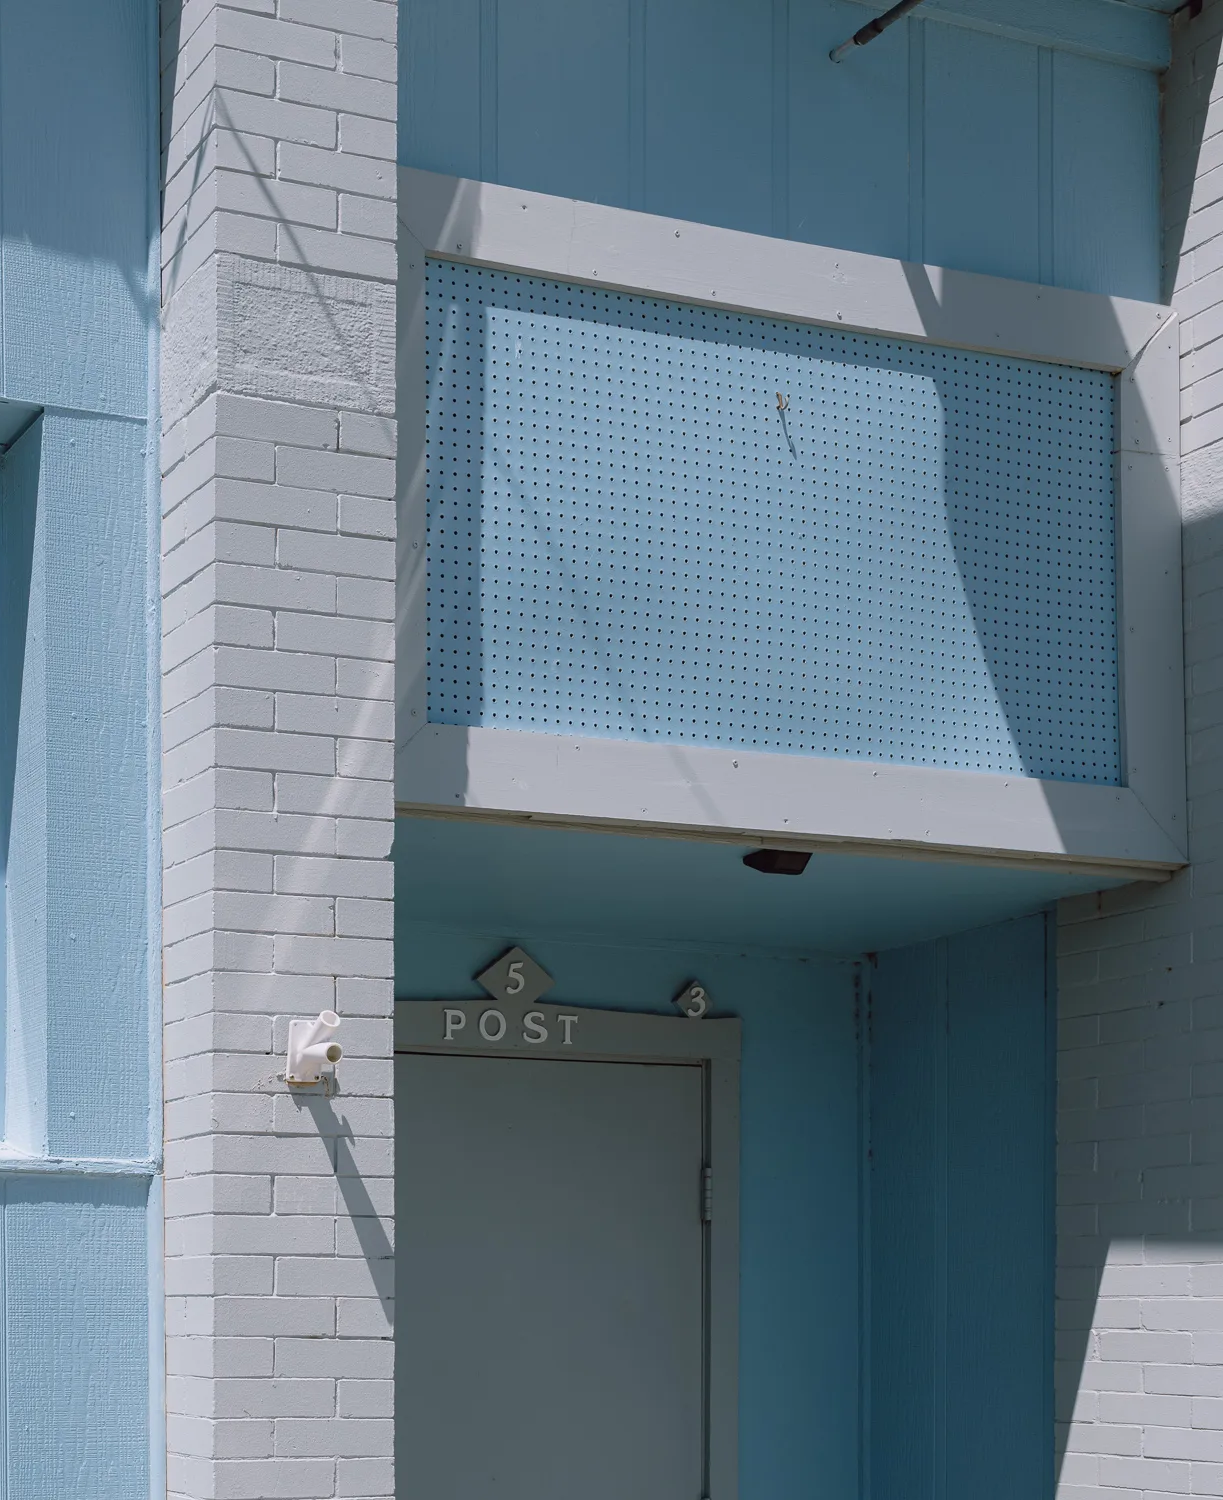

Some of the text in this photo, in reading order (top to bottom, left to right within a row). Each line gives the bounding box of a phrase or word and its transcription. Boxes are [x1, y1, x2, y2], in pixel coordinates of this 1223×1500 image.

[506, 962, 525, 995] 5
[687, 986, 706, 1017] 3
[443, 1008, 579, 1046] POST
